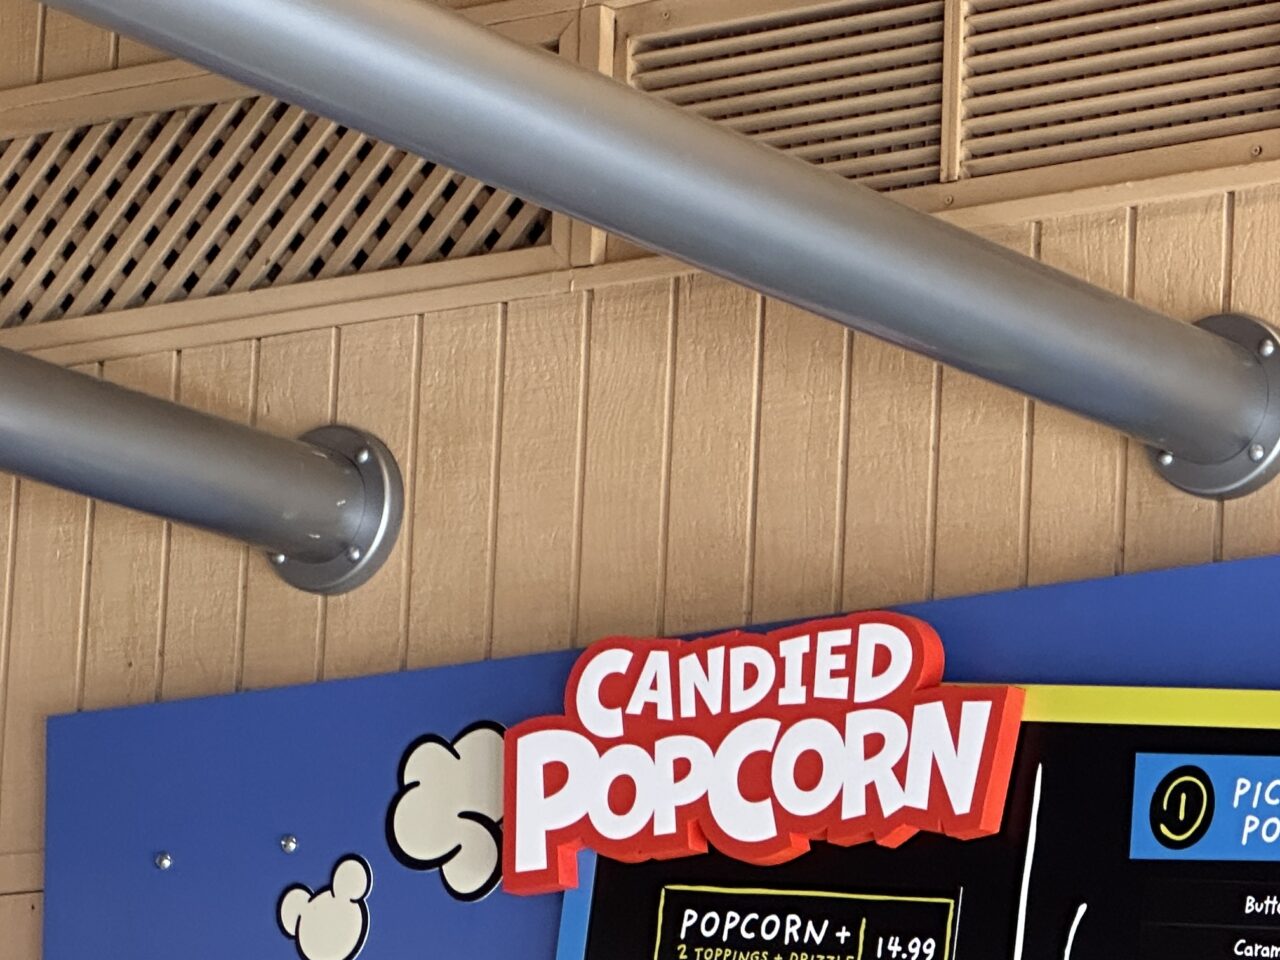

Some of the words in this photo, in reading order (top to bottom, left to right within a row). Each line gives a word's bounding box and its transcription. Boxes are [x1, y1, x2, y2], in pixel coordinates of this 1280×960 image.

[575, 622, 913, 738] CANDIED
[515, 700, 993, 873] POPCORN
[677, 944, 688, 960] 2
[680, 908, 829, 945] POPCORN
